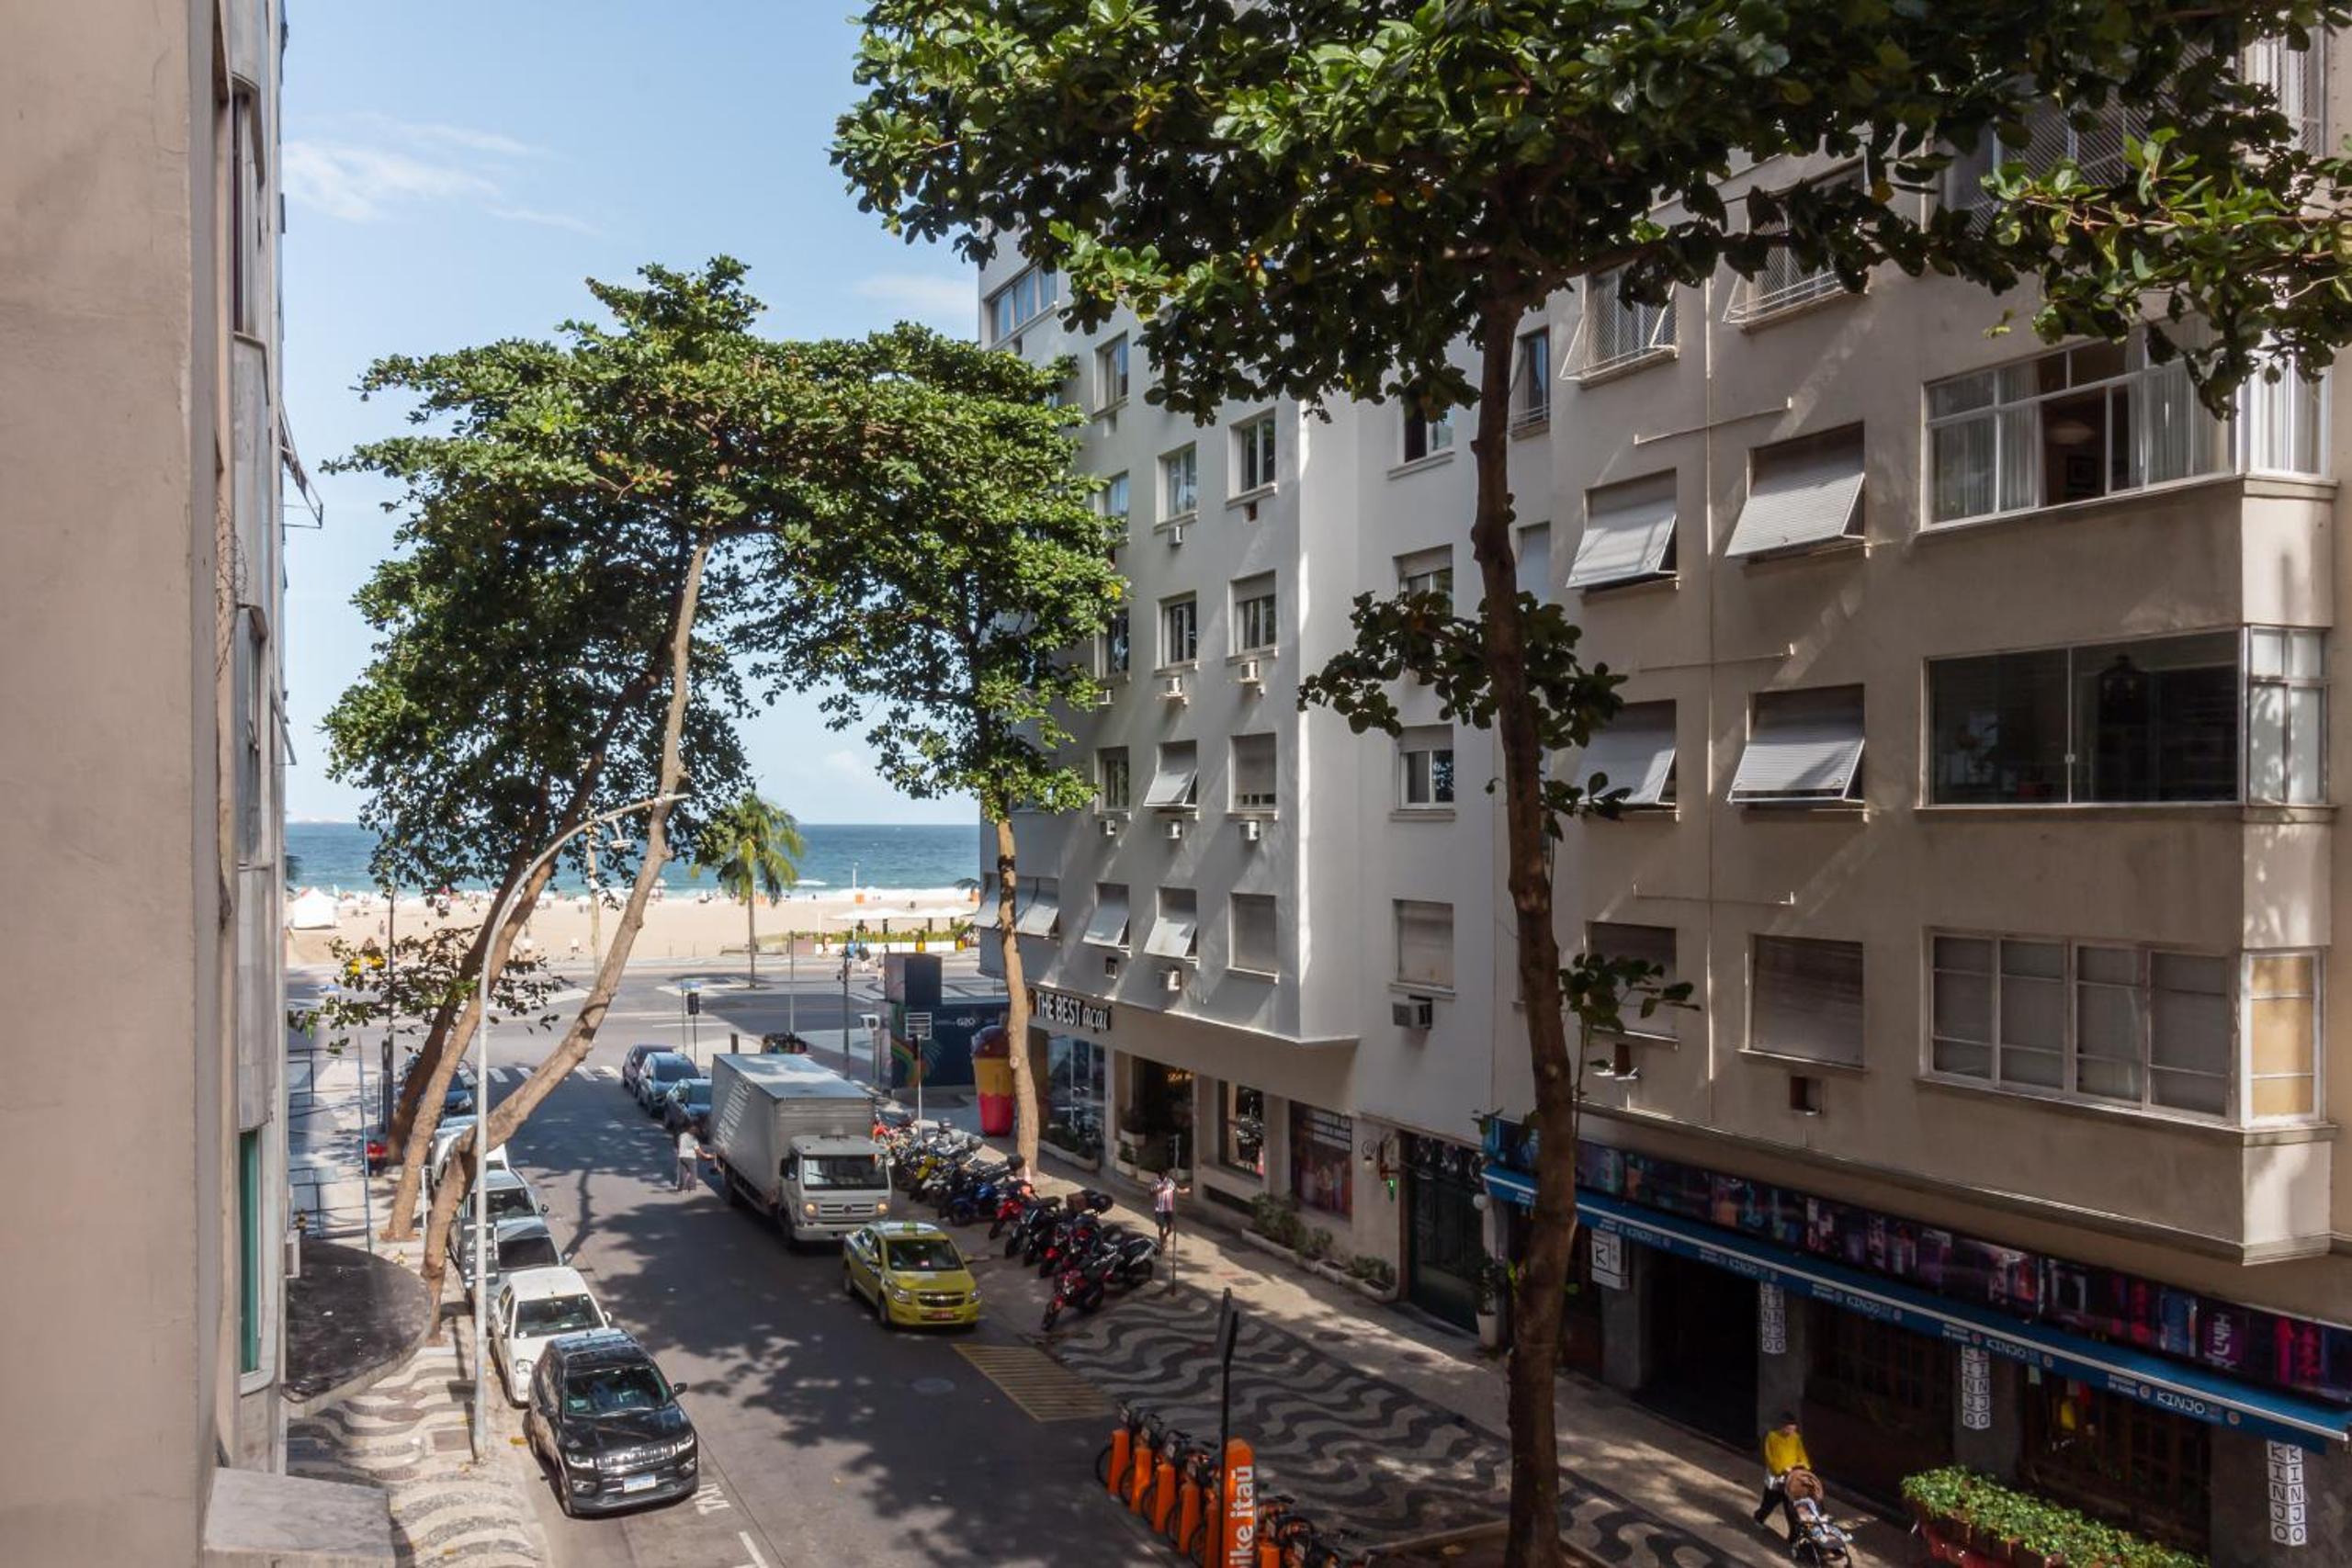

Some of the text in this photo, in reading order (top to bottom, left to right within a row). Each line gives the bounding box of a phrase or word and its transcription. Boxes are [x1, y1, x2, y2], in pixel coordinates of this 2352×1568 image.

[1036, 991, 1055, 1020] THE
[1056, 996, 1081, 1027] BEST
[2156, 1390, 2206, 1415] KINJO
[2270, 1442, 2289, 1540] KINJO
[2289, 1446, 2304, 1542] KINJO
[1228, 1525, 1254, 1568] ike
